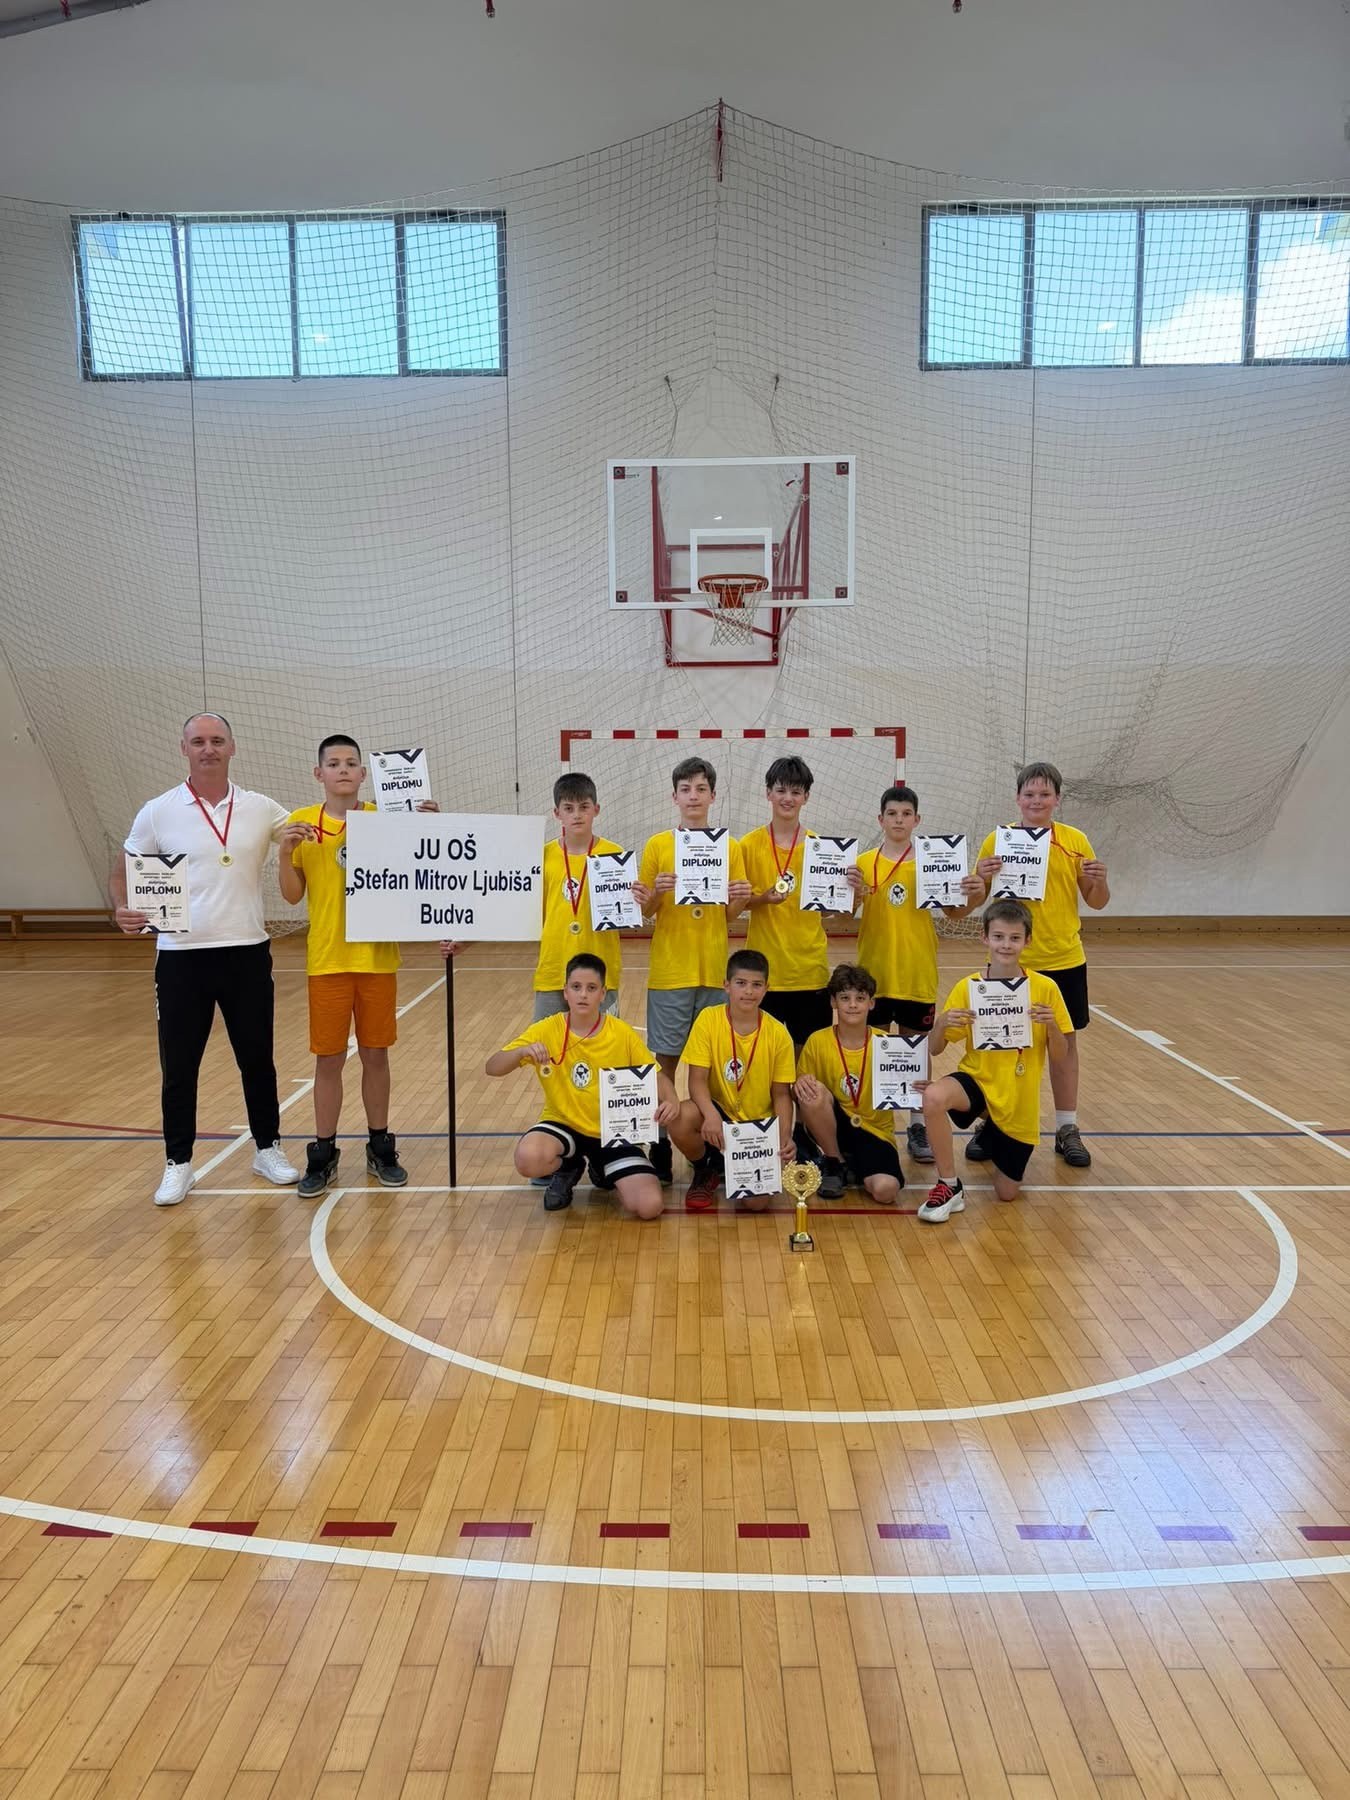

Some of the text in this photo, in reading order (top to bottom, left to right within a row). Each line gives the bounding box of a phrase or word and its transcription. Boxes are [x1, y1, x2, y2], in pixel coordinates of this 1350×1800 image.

[381, 779, 422, 791] DIPLOMU
[405, 799, 412, 811] 1
[414, 833, 477, 860] JU OŠ
[680, 859, 722, 867] DIPLOMU
[1002, 855, 1041, 865] DIPLOMU
[810, 866, 849, 875] DIPLOMU
[923, 864, 961, 872] DIPLOMU
[345, 866, 541, 896] „Stefan Mitrov Ljubiša“
[702, 877, 709, 889] 1
[1020, 874, 1026, 886] 1
[135, 886, 182, 894] DIPLOMU
[595, 882, 632, 893] DIPLOMU
[828, 885, 835, 897] 1
[942, 882, 949, 894] 1
[159, 905, 167, 918] 1
[615, 901, 621, 914] 1
[420, 903, 474, 925] Budva
[978, 1007, 1023, 1016] DIPLOMU
[1002, 1024, 1010, 1036] 1
[880, 1064, 920, 1072] DIPLOMU
[900, 1082, 907, 1094] 1
[608, 1097, 650, 1108] DIPLOMU
[630, 1117, 637, 1130] 1
[732, 1148, 774, 1160] DIPLOMU
[754, 1168, 761, 1182] 1
